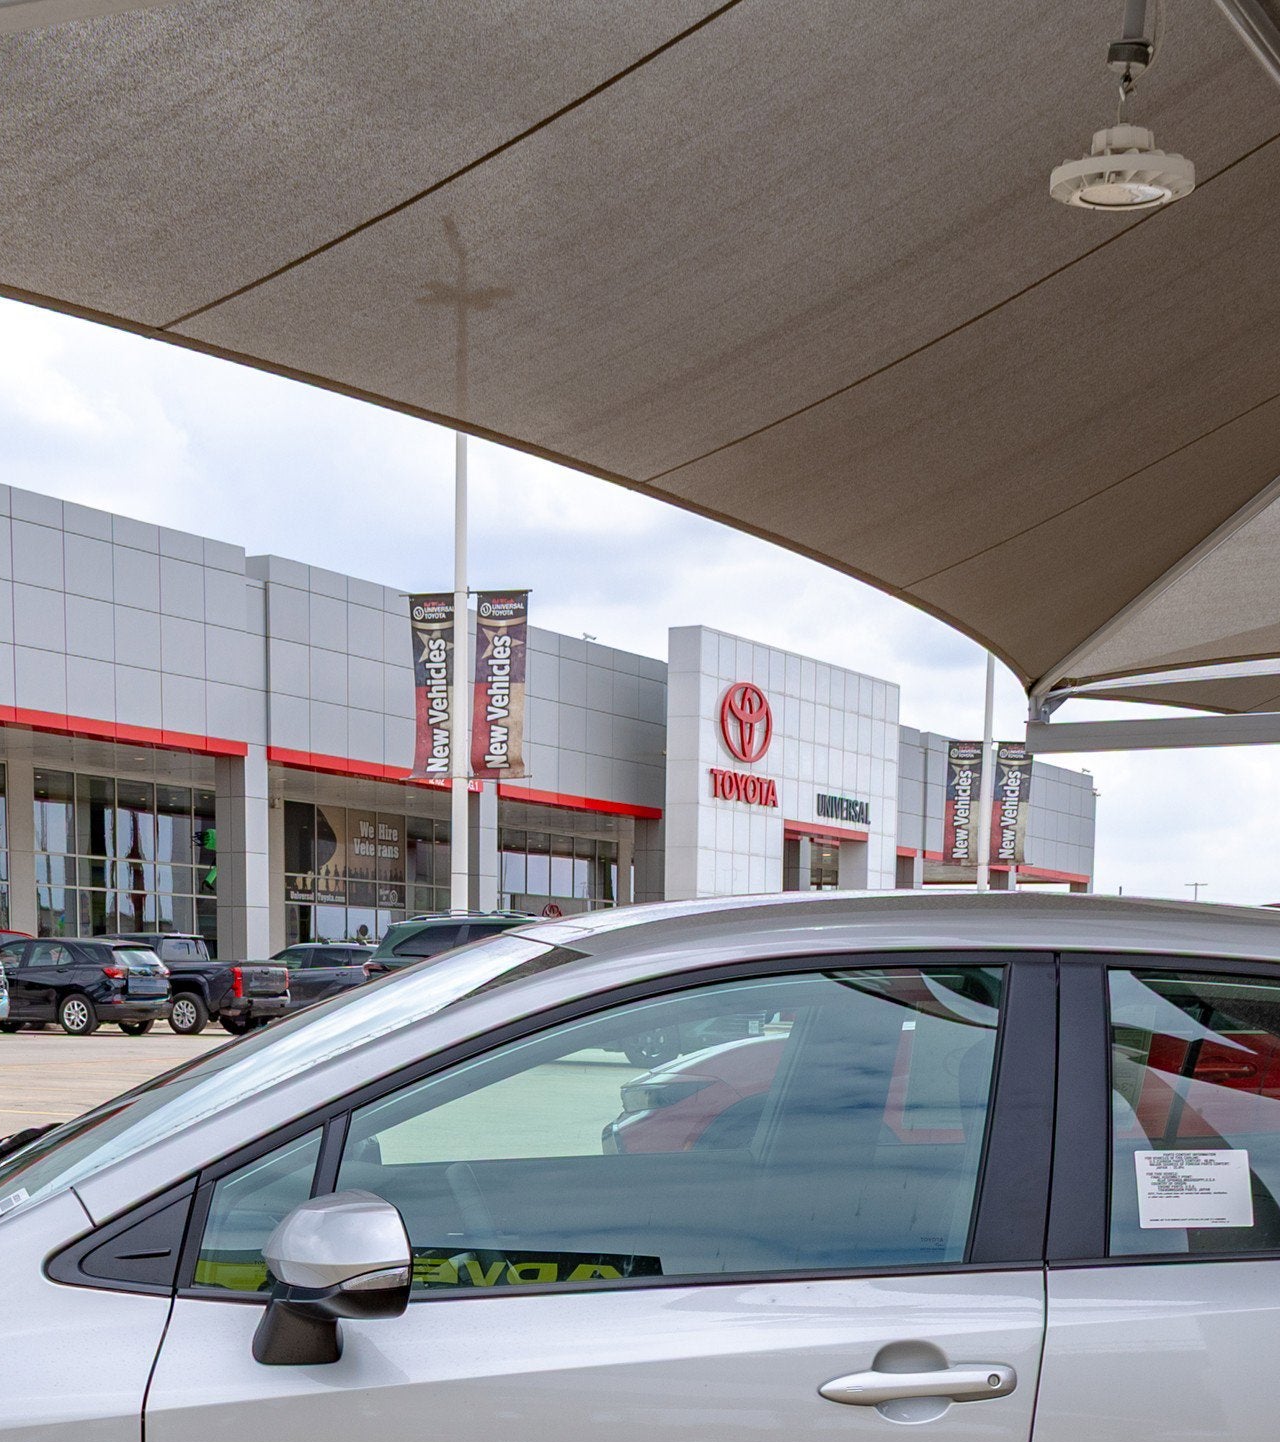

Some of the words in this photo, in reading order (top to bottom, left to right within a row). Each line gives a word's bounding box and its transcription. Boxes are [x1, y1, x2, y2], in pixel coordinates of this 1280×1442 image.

[492, 602, 524, 610] UNIVERSAL
[425, 638, 448, 722] Vehicles
[487, 634, 511, 722] Vehicles
[426, 728, 449, 773] New
[485, 726, 509, 769] New
[710, 768, 778, 808] TOYOTA
[954, 770, 972, 827] Vehicles
[1000, 771, 1021, 827] Vehicles
[816, 793, 871, 825] UNIVERSAL
[353, 838, 400, 859] Veterans
[359, 821, 375, 838] We
[378, 823, 398, 841] Hire
[952, 829, 969, 859] New
[999, 829, 1016, 859] New
